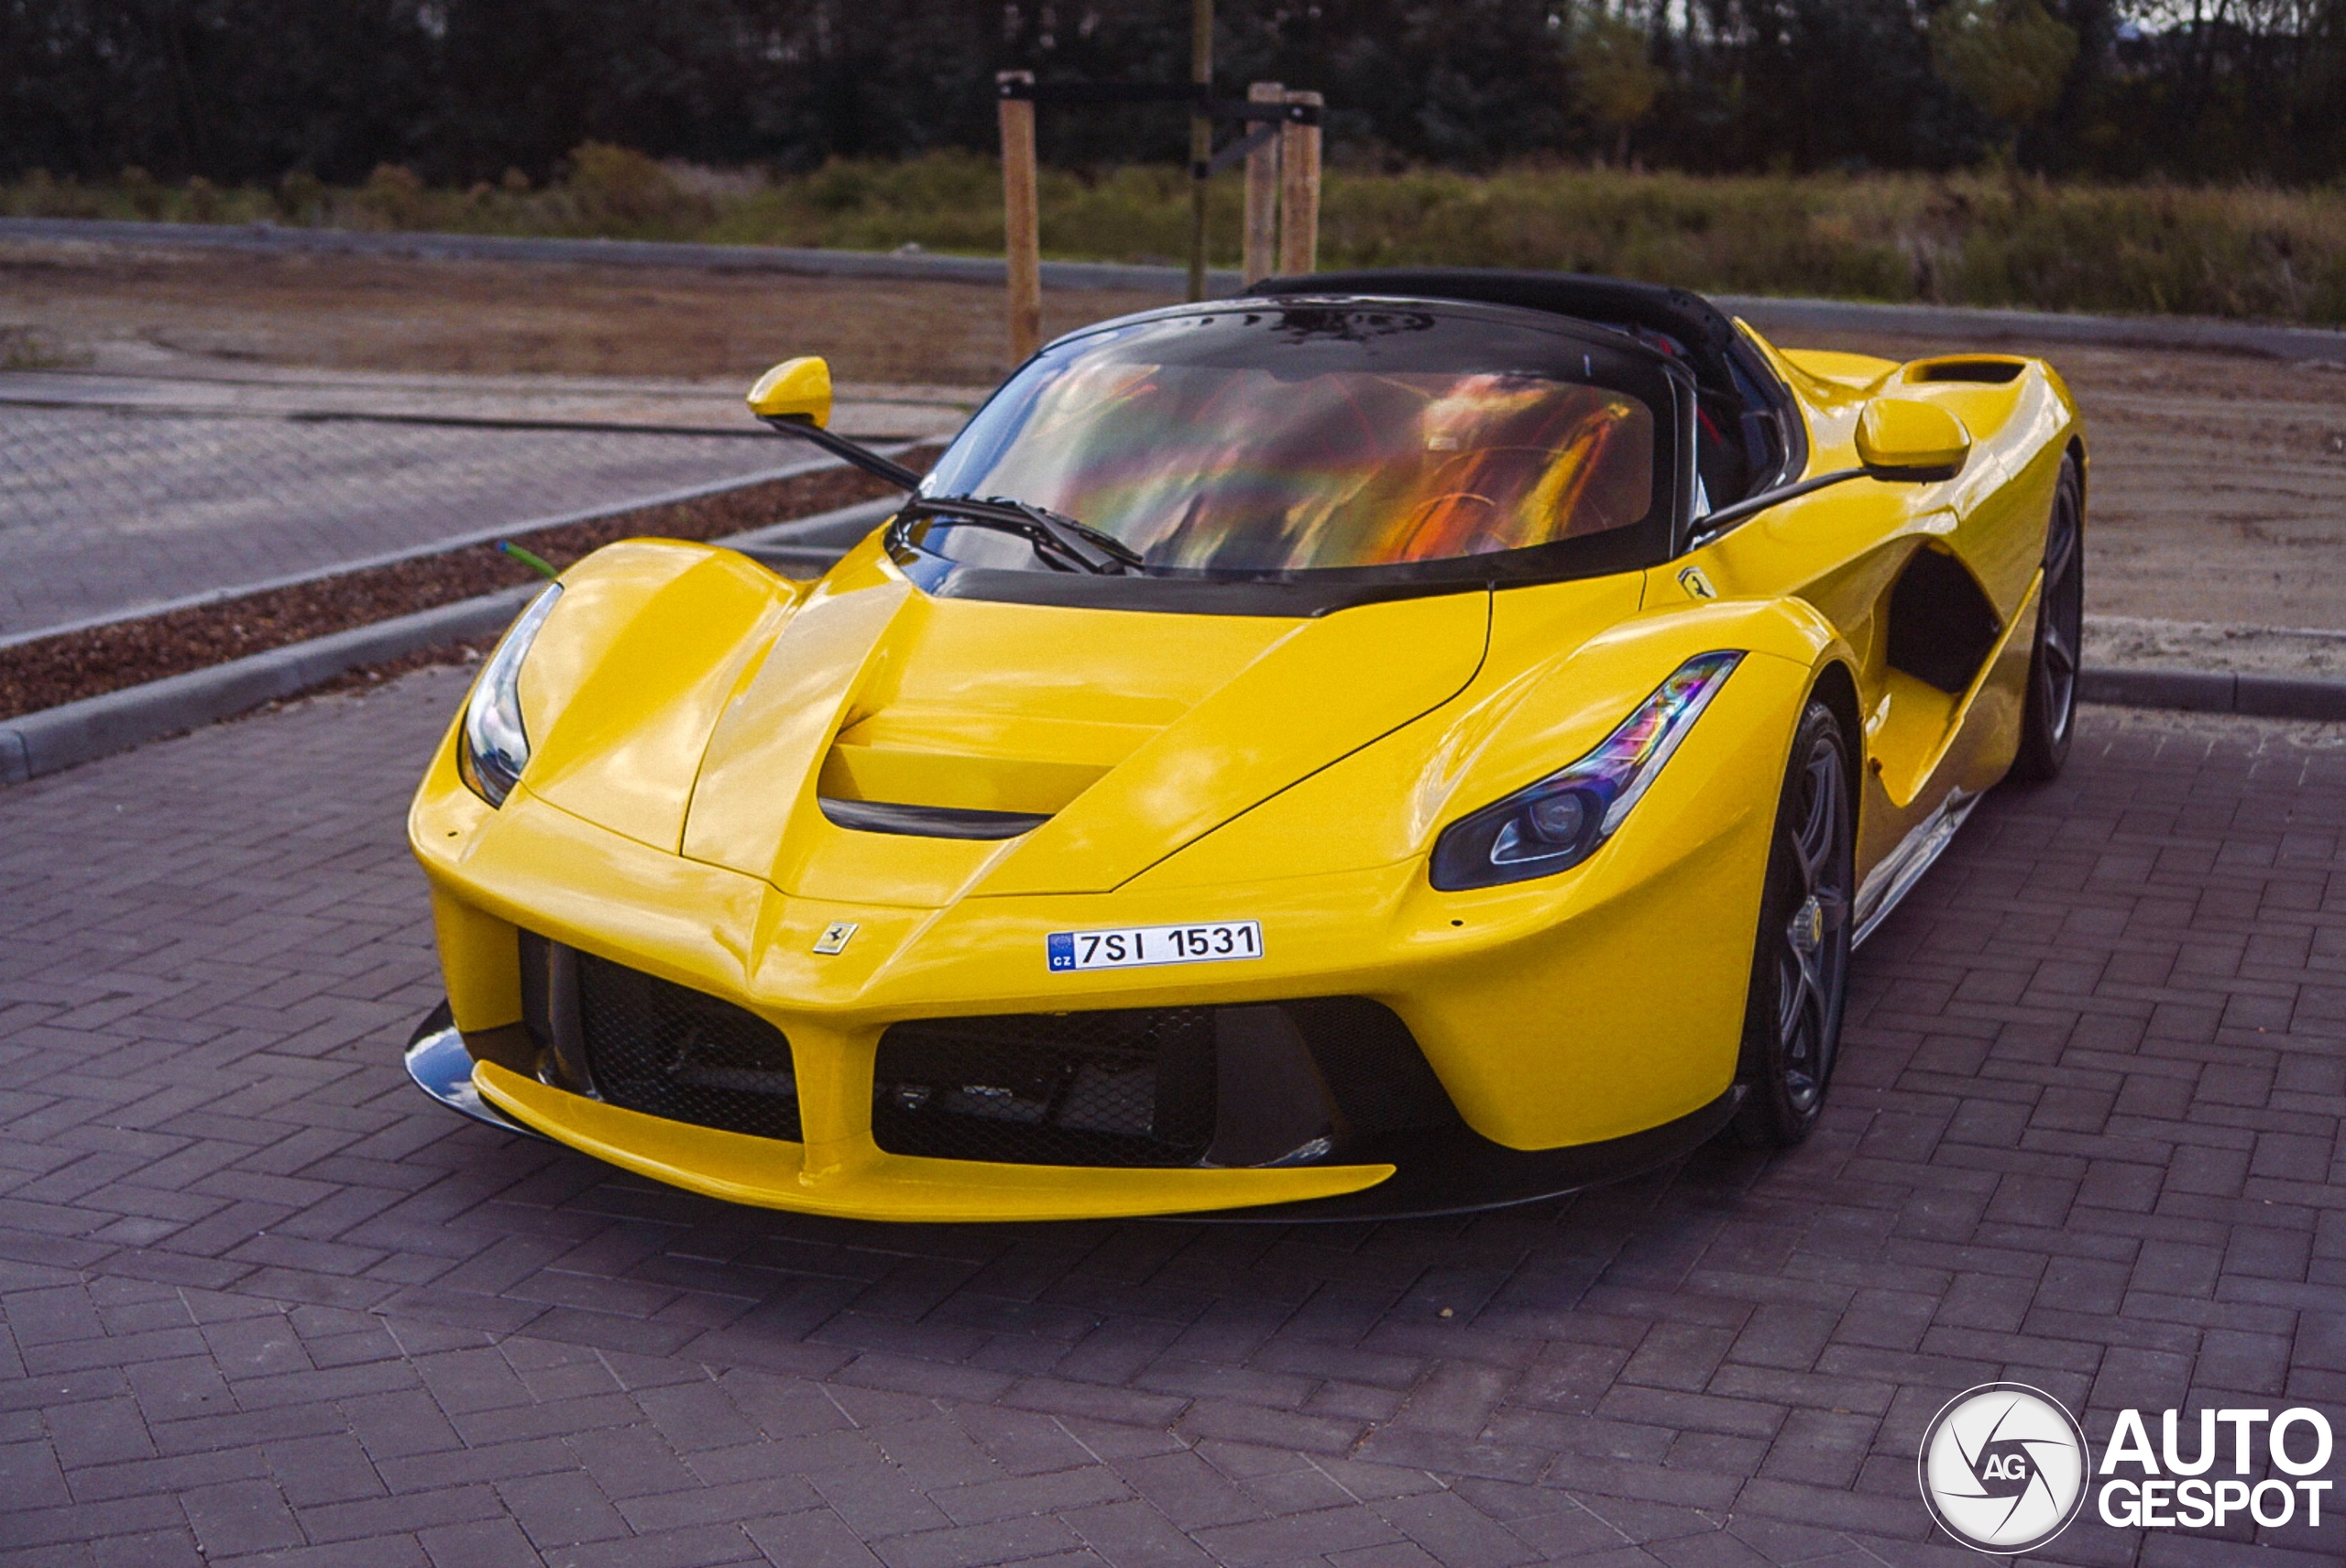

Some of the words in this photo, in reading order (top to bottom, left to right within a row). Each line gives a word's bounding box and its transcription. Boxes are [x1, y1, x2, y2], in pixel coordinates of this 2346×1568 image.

[1080, 933, 1144, 964] 7SI
[1168, 926, 1255, 958] 1531
[1053, 956, 1071, 967] CZ
